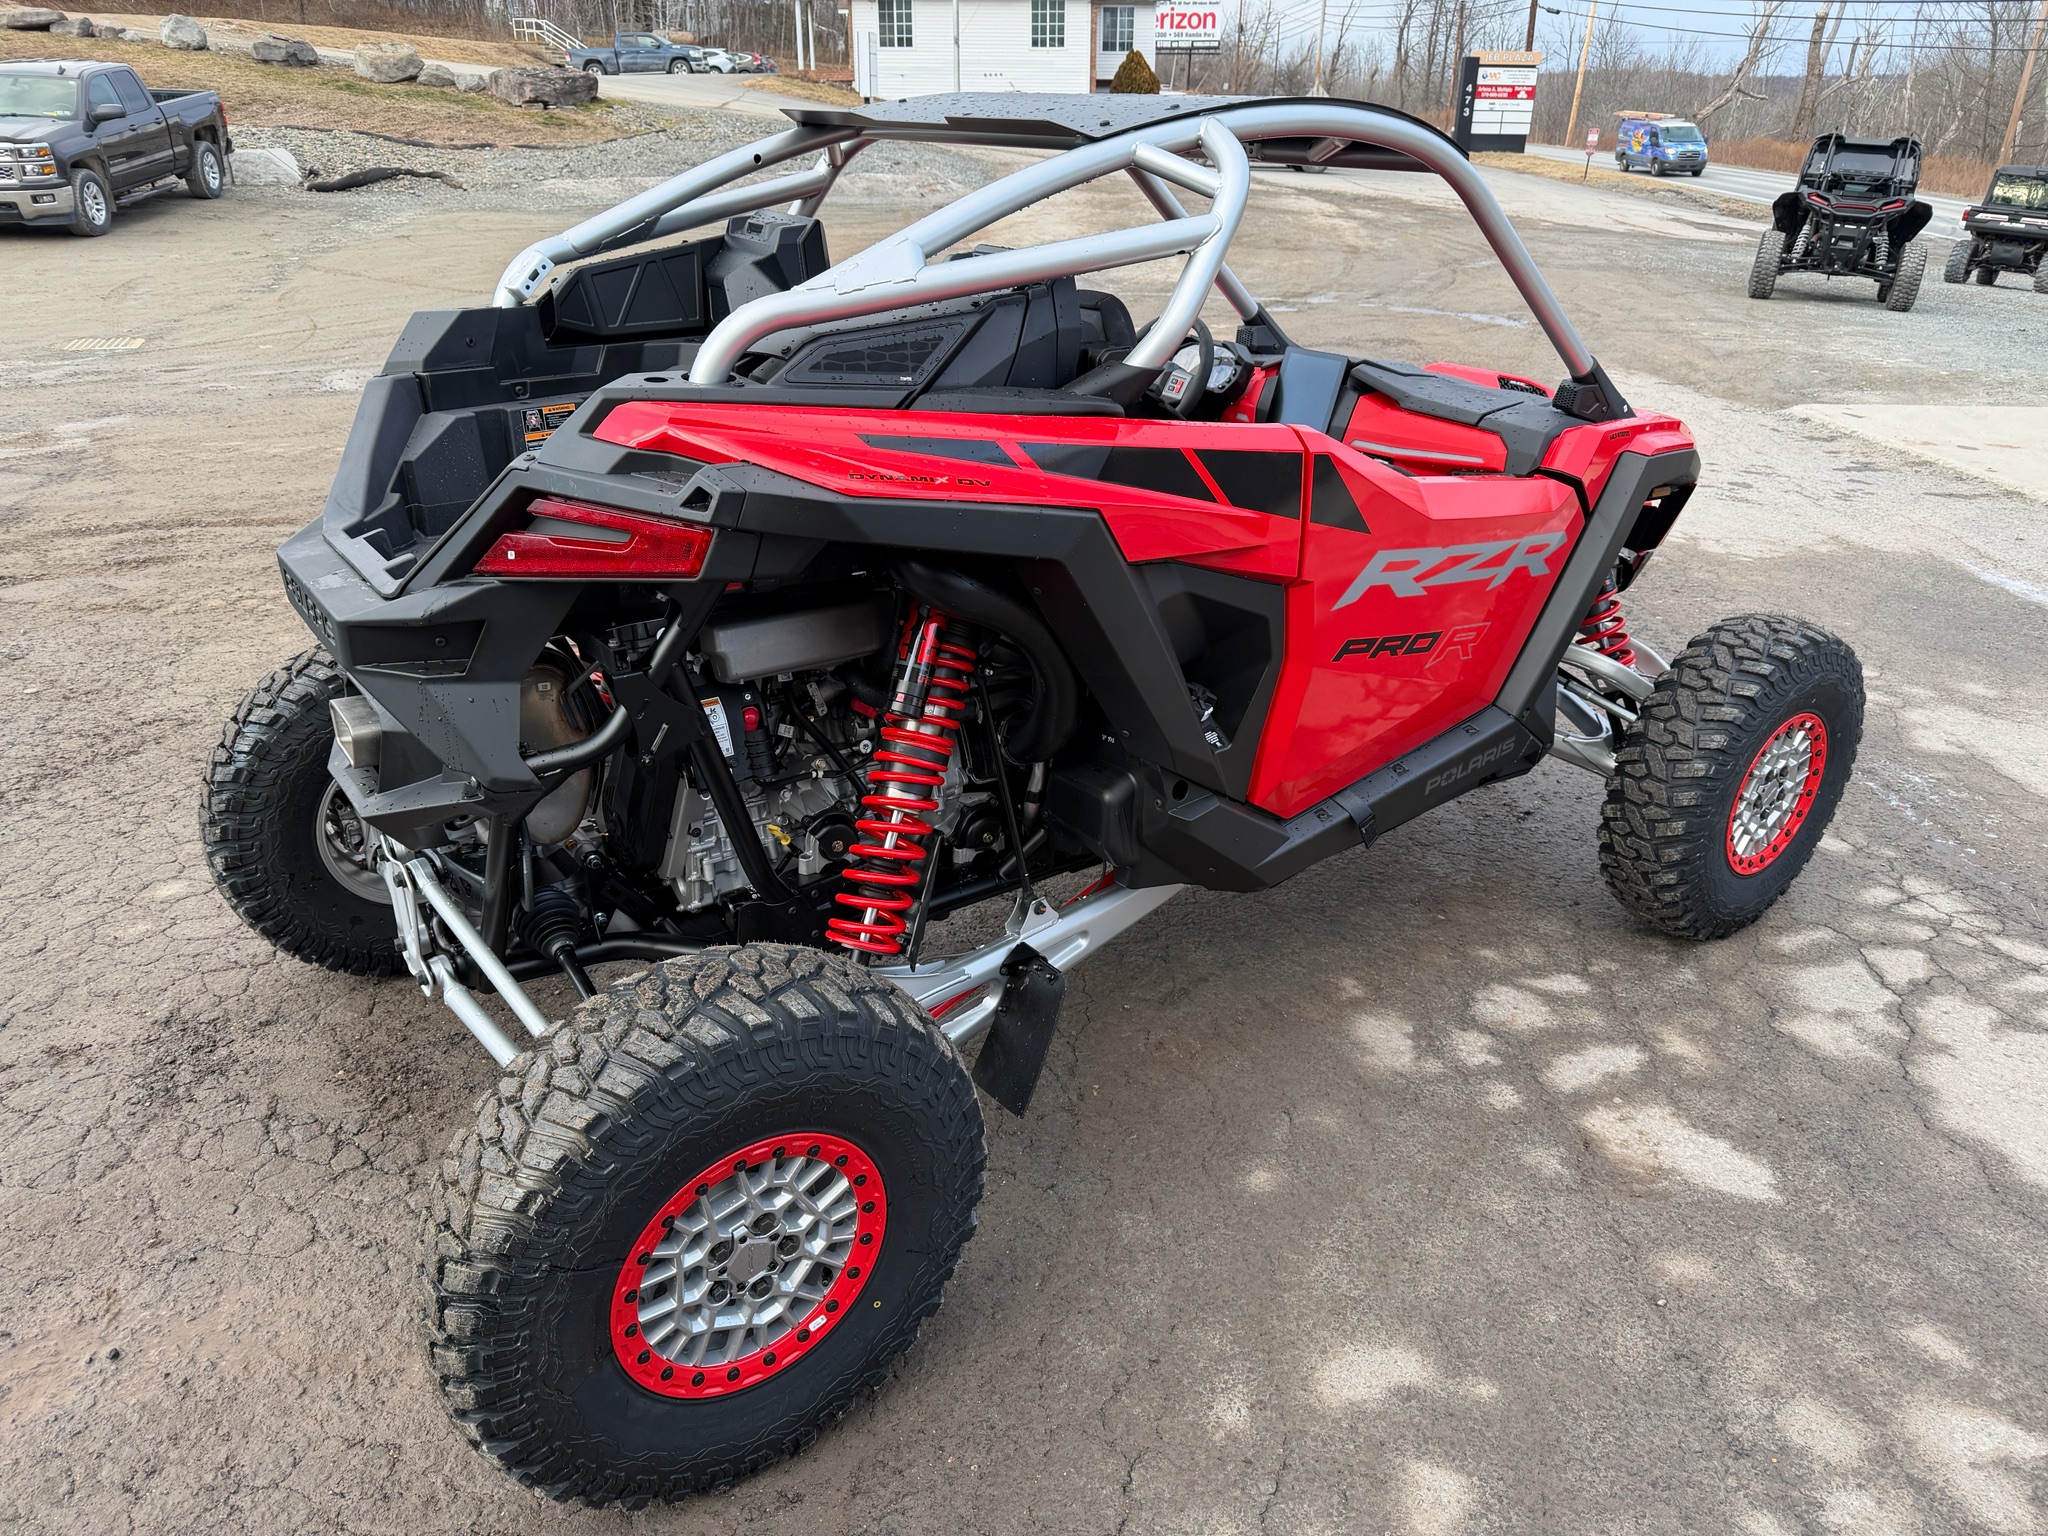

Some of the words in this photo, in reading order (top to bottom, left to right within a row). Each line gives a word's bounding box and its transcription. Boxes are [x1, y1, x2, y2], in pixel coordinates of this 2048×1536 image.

[1156, 7, 1216, 29] rizon
[1486, 53, 1500, 62] JEB
[1503, 53, 1534, 62] PLAZA
[849, 473, 949, 485] DYNAMIX
[957, 478, 991, 487] DV
[1330, 530, 1568, 612] RZR
[1331, 631, 1444, 663] PRO
[1424, 735, 1516, 797] POLARIS
